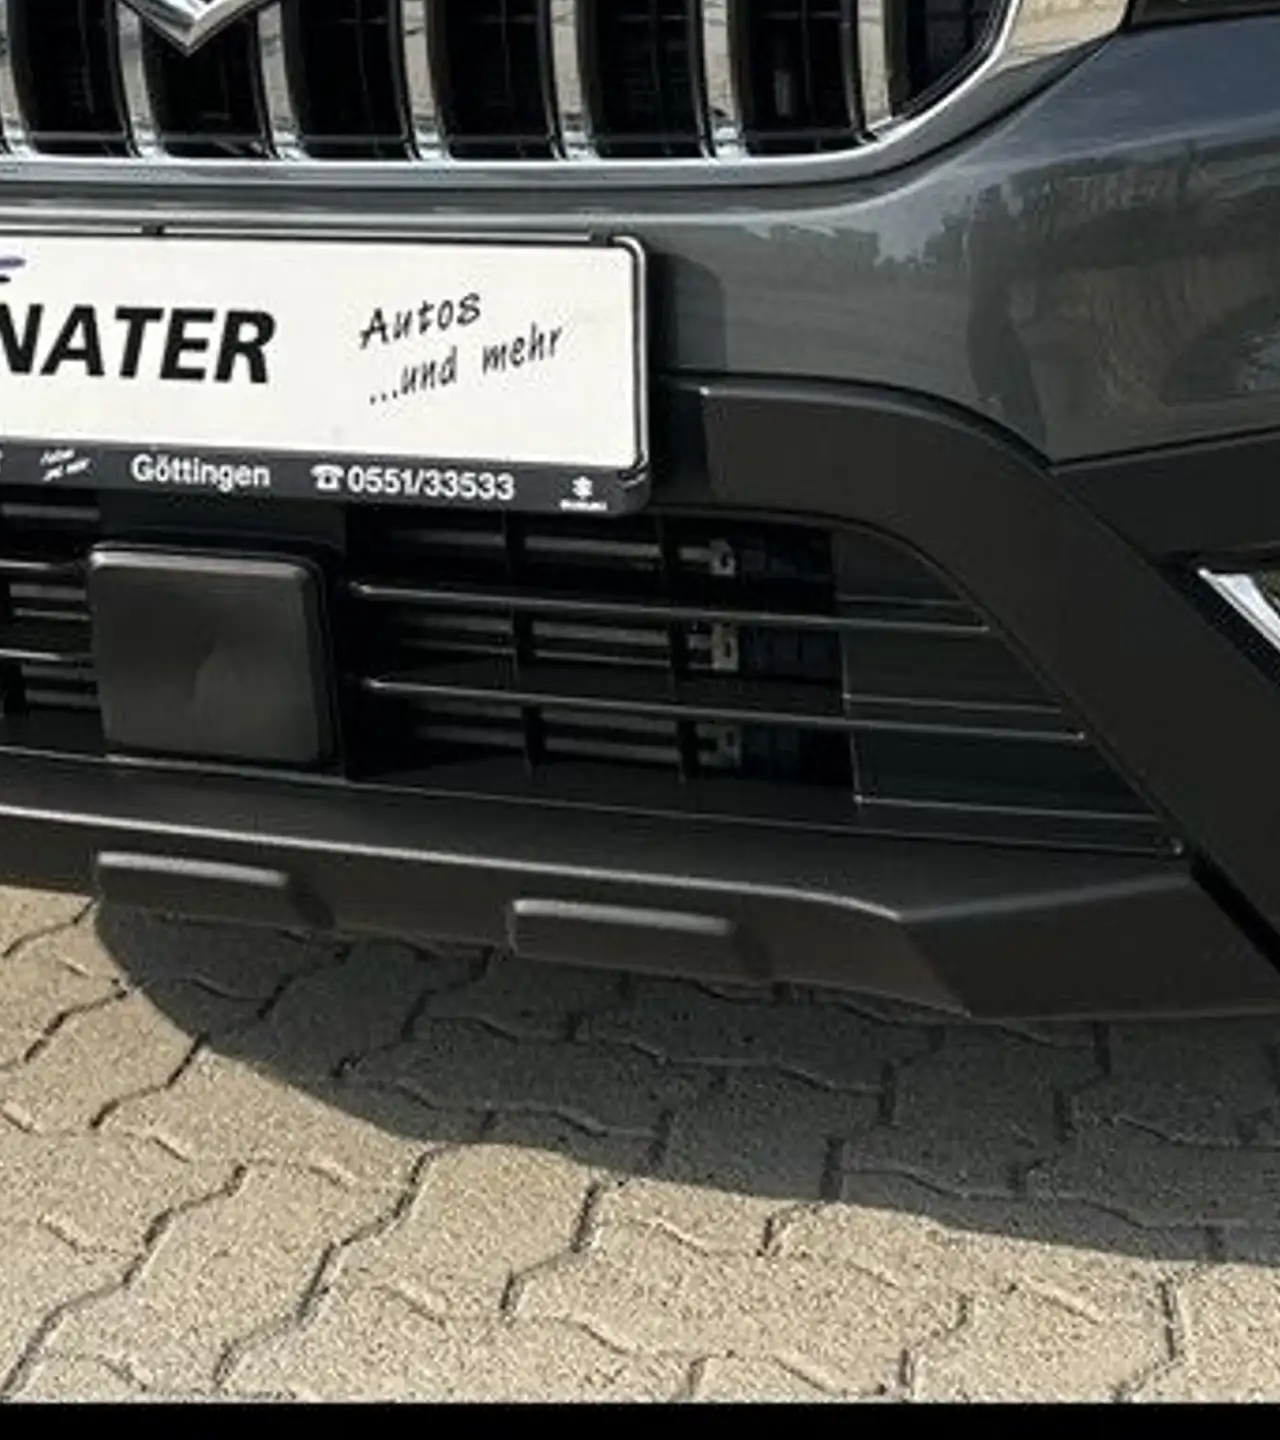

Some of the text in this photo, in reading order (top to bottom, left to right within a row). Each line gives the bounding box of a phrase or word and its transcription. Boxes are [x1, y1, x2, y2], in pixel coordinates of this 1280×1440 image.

[360, 291, 483, 350] Autos
[480, 322, 565, 375] mehr
[130, 453, 271, 492] Göttingen
[346, 464, 516, 501] 0551/33533
